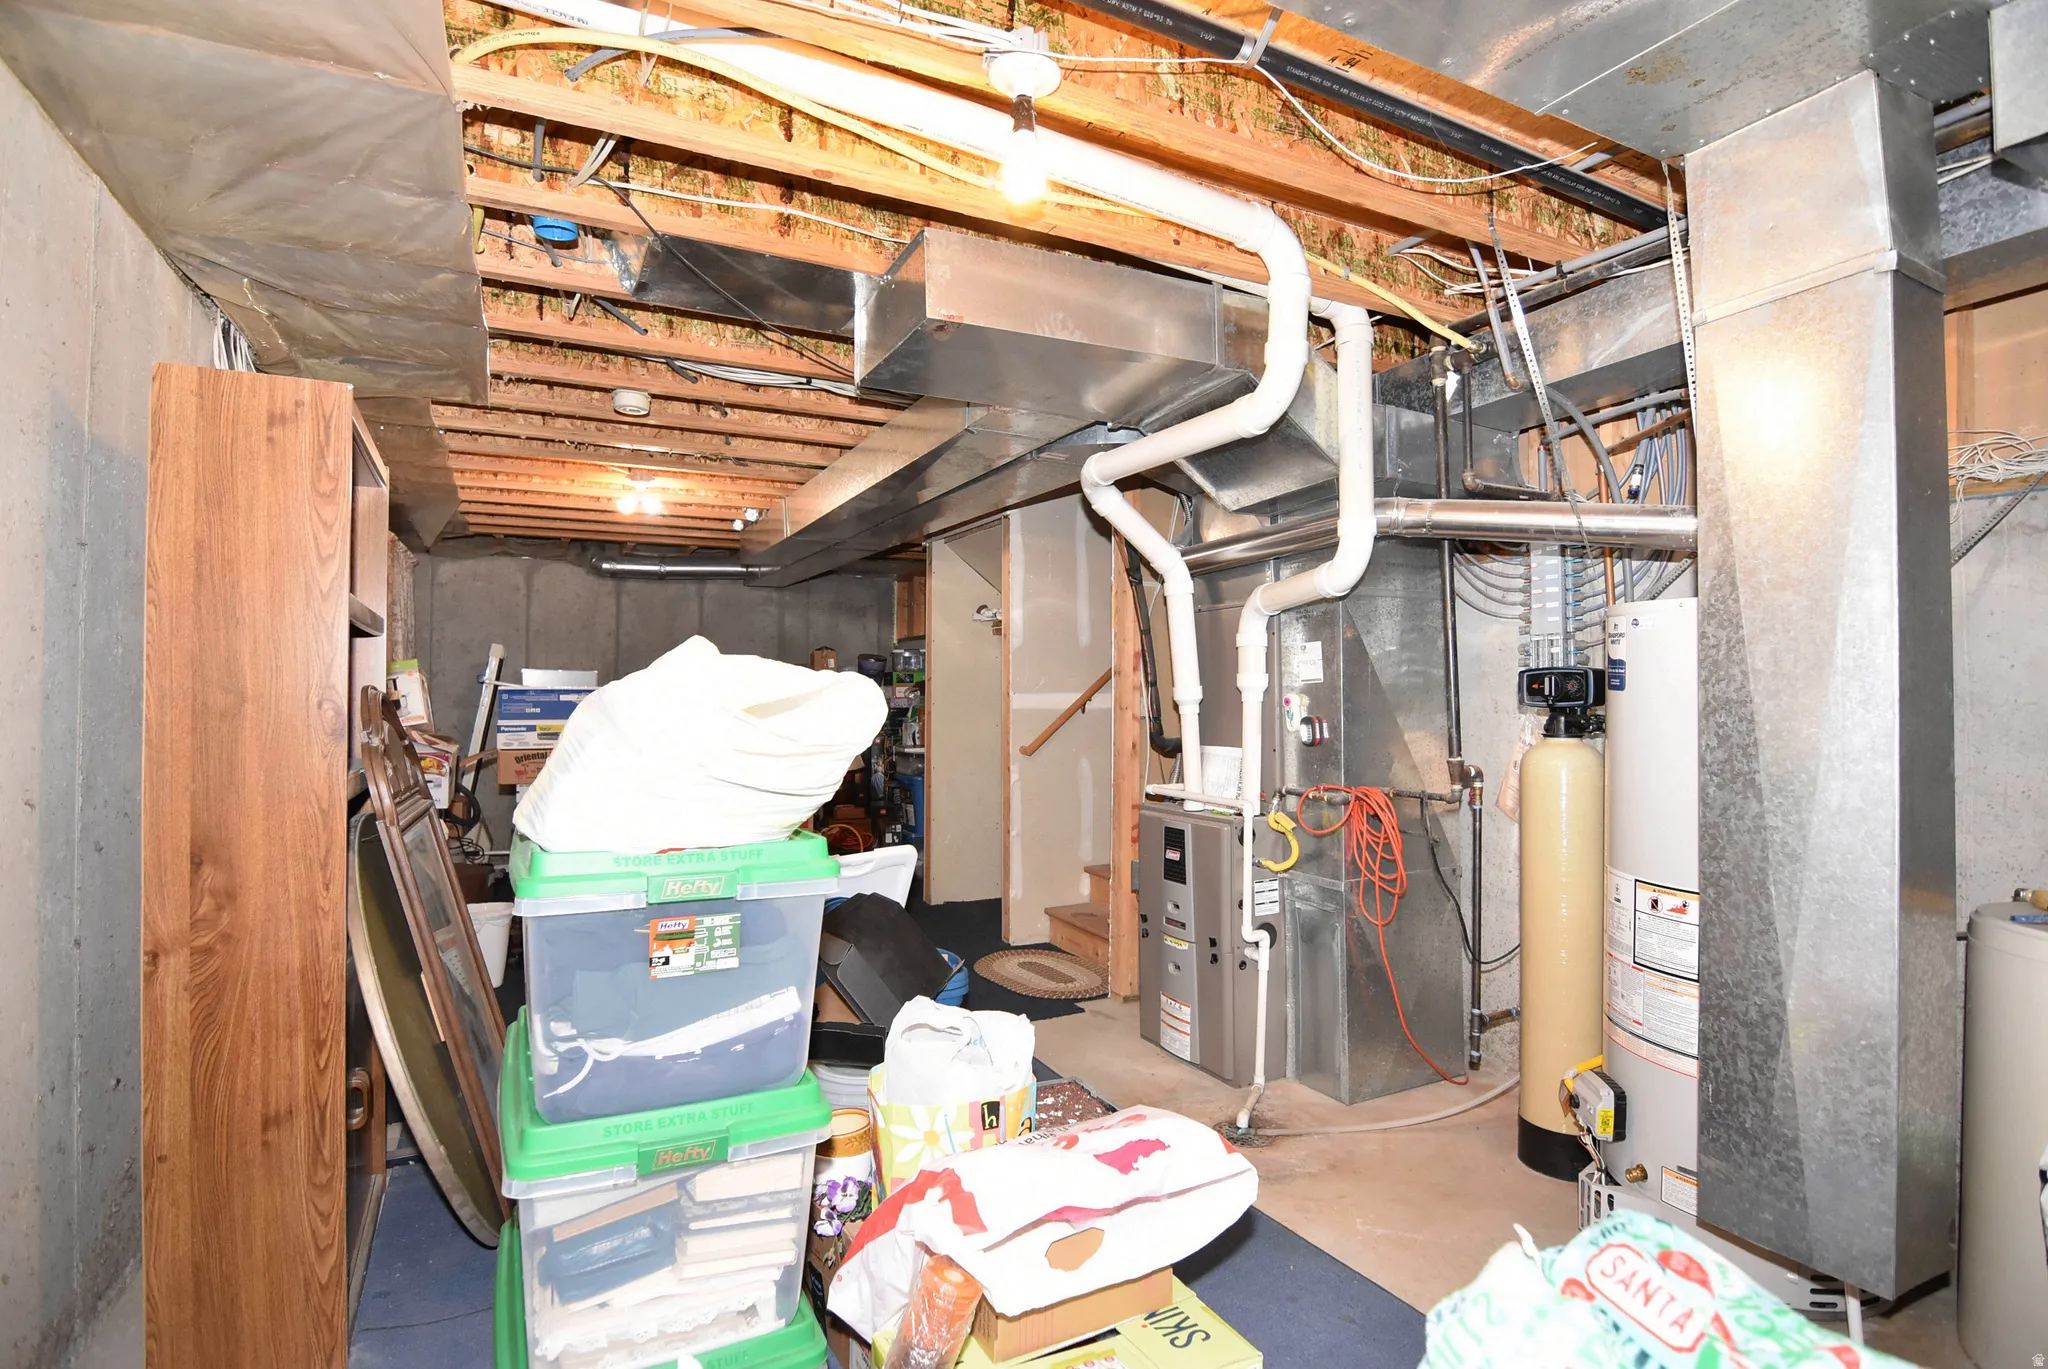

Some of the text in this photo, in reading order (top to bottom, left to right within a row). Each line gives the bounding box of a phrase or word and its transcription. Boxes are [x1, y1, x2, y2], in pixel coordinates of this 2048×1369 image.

[612, 848, 764, 868] STORE EXTRA STUFF
[665, 879, 720, 897] Hefty
[659, 920, 688, 931] Hefty
[603, 1102, 756, 1138] STORE EXTRA STUFF
[657, 1143, 711, 1166] Hefty
[1600, 1254, 1694, 1334] SANTA
